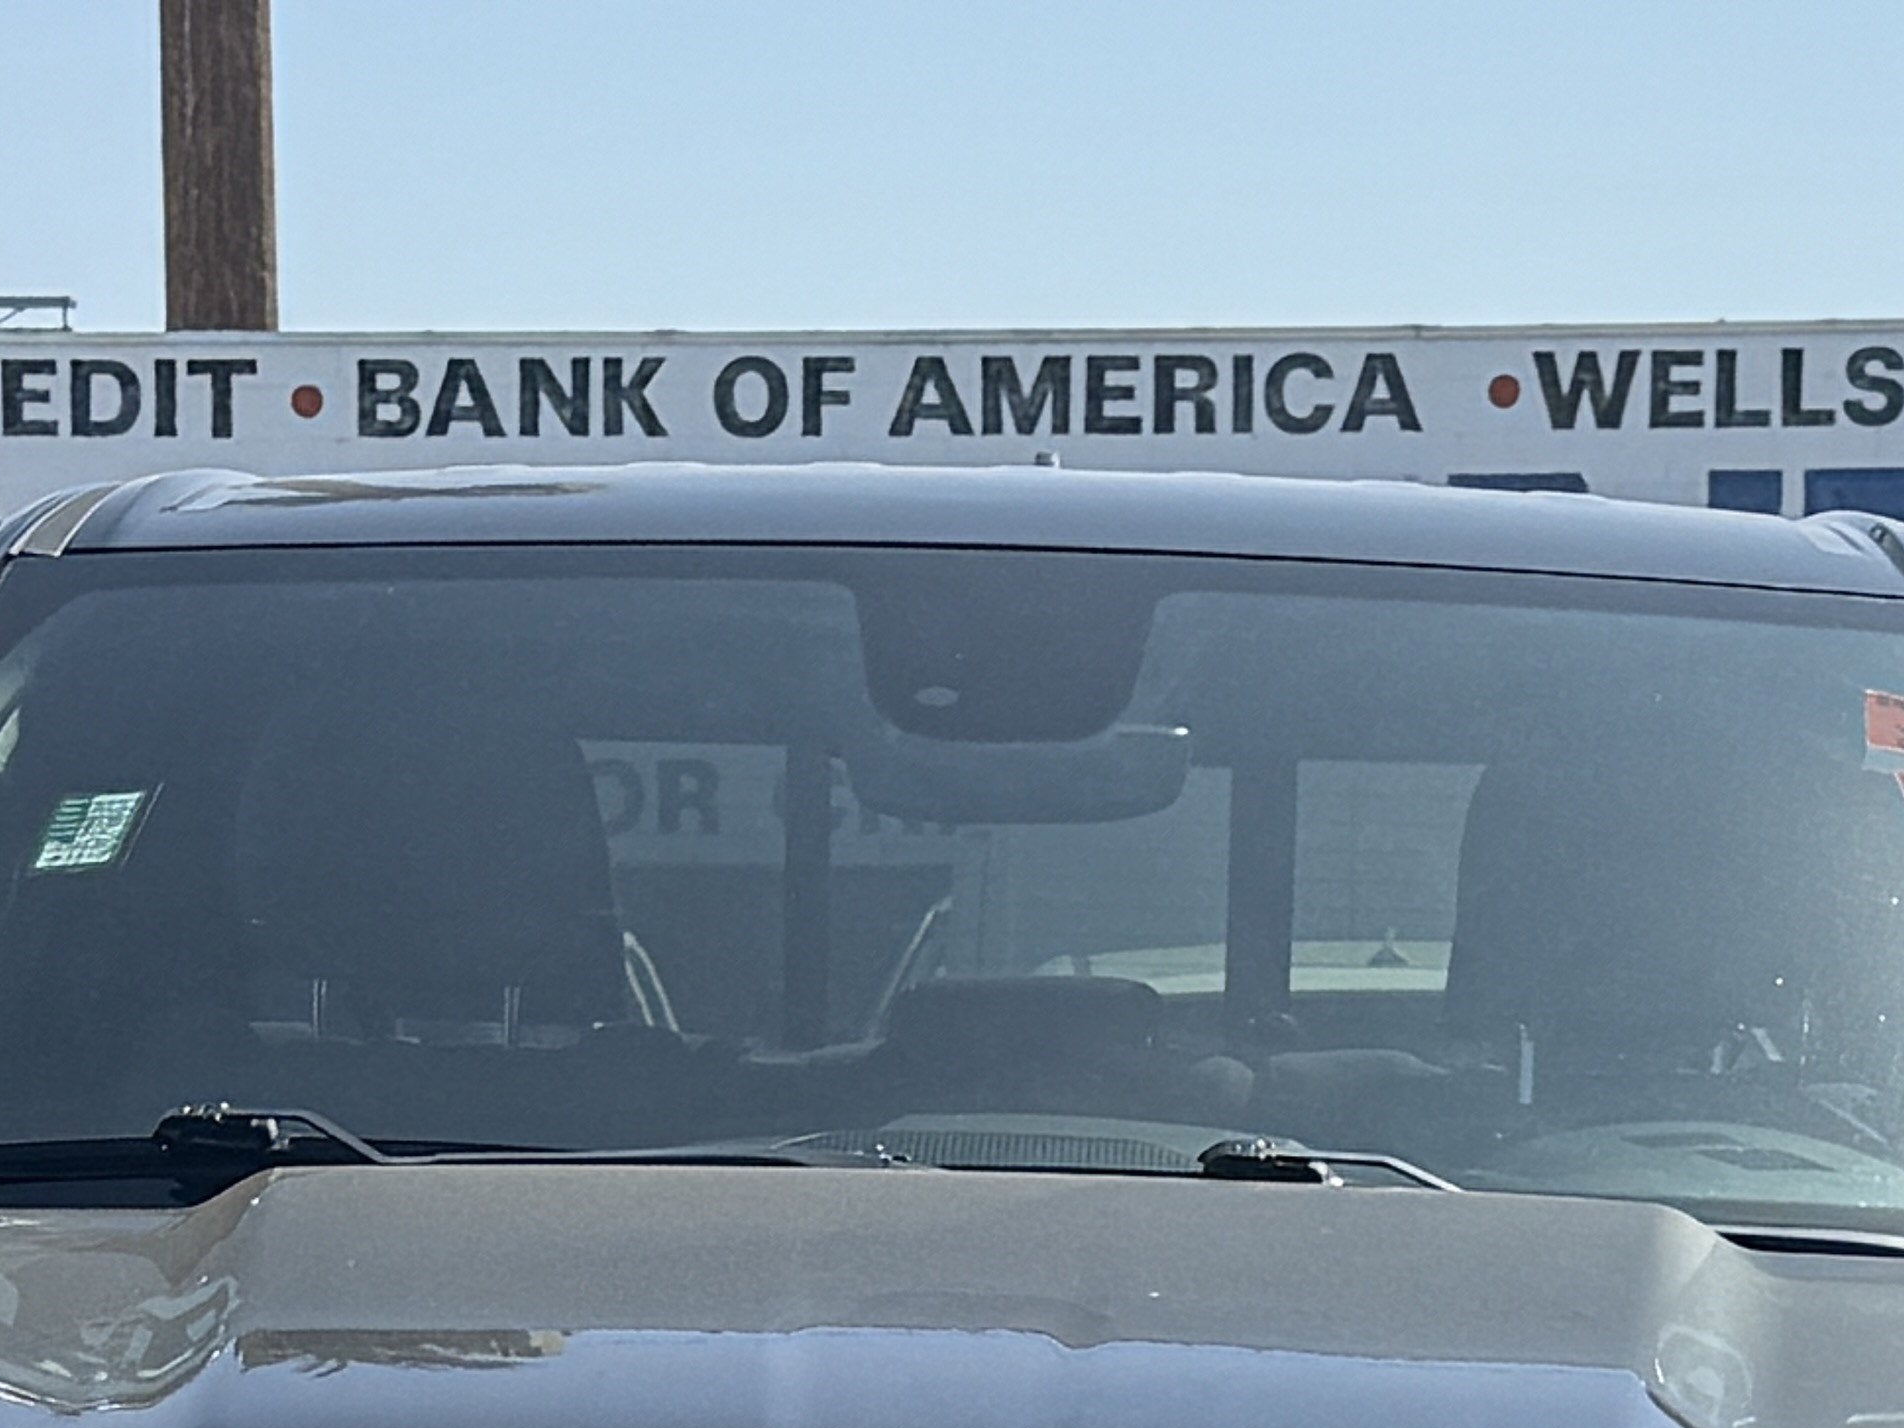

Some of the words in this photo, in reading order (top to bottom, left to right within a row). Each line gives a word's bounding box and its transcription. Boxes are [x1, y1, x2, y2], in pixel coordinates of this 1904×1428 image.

[357, 357, 668, 438] BANK
[713, 356, 855, 438] OF
[889, 353, 1423, 437] AMERICA
[1533, 347, 1904, 430] WELLS
